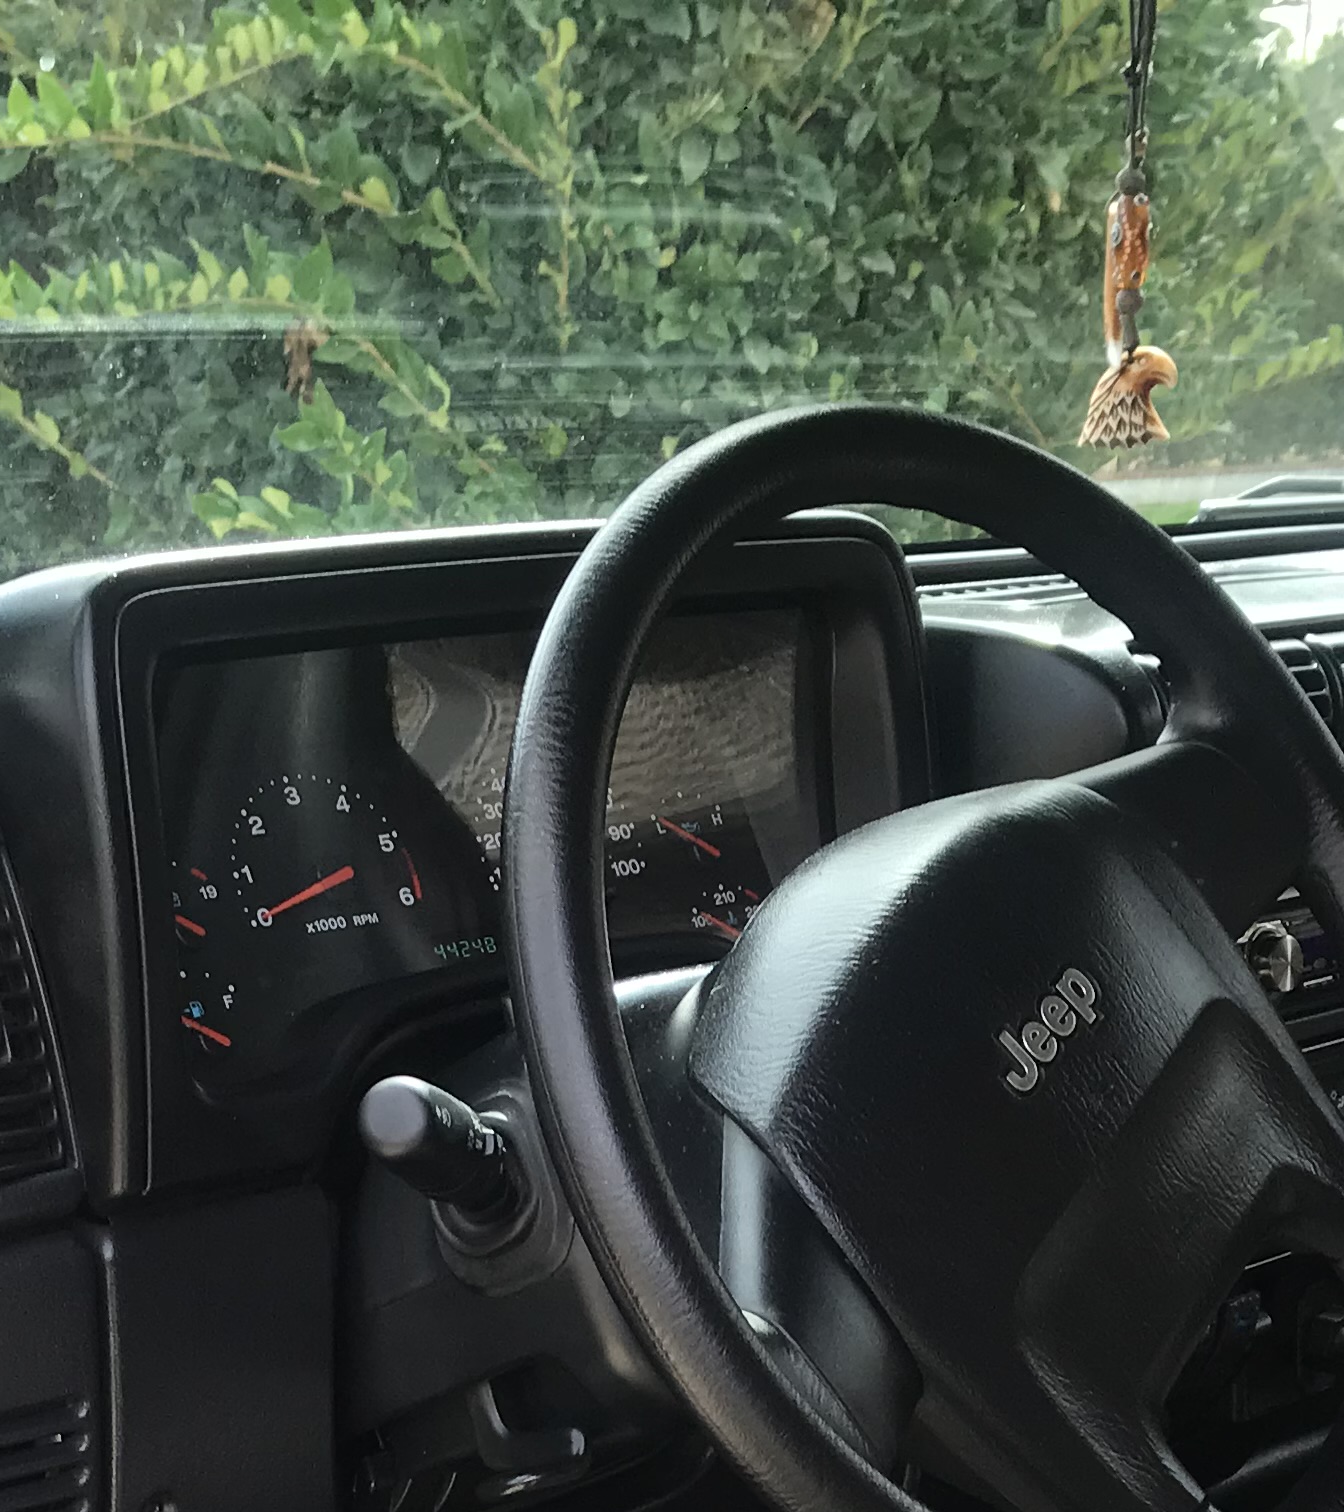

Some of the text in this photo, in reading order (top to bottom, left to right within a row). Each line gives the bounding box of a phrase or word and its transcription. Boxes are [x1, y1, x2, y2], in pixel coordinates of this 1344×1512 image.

[284, 786, 301, 806] 3
[336, 794, 350, 813] 4
[248, 816, 266, 836] 2
[656, 822, 666, 835] L
[711, 813, 723, 826] H
[608, 824, 632, 841] 90
[378, 833, 395, 853] 5
[240, 865, 253, 884] 1
[611, 859, 641, 877] 100
[199, 885, 218, 900] 19
[398, 887, 414, 906] 6
[713, 891, 736, 906] 210
[256, 907, 273, 927] 0
[352, 912, 380, 927] RPM
[434, 936, 497, 960] 44248
[222, 994, 234, 1009] F
[999, 967, 1097, 1091] Jeep
